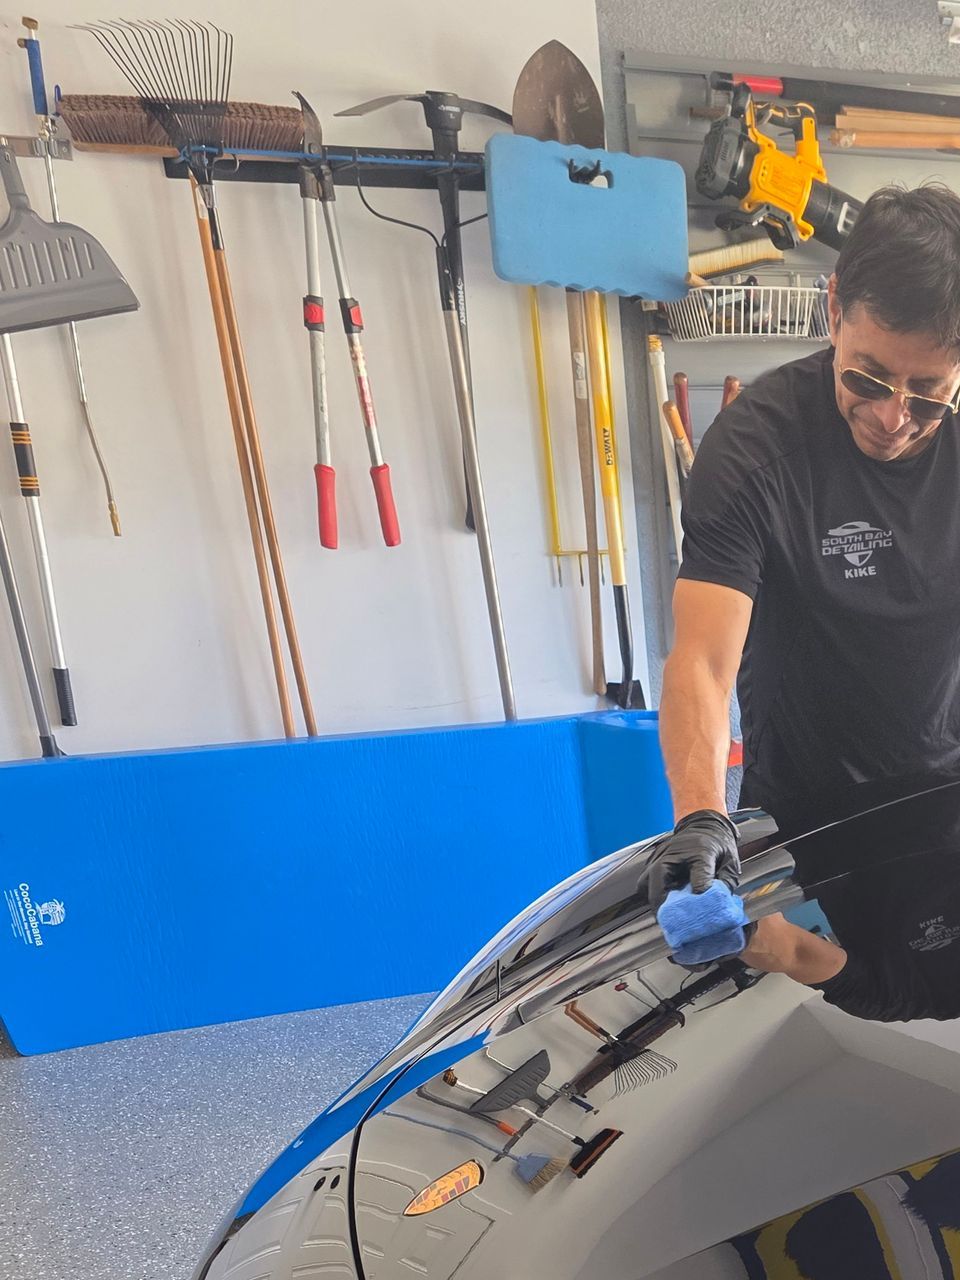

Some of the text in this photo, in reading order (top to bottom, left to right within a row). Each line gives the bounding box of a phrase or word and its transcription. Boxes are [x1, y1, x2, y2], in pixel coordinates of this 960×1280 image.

[457, 289, 467, 327] HUSKY
[822, 529, 893, 547] SOUTH BAY
[822, 538, 893, 556] DETAILING
[844, 565, 877, 579] KIKE
[18, 883, 43, 947] CocoCabana
